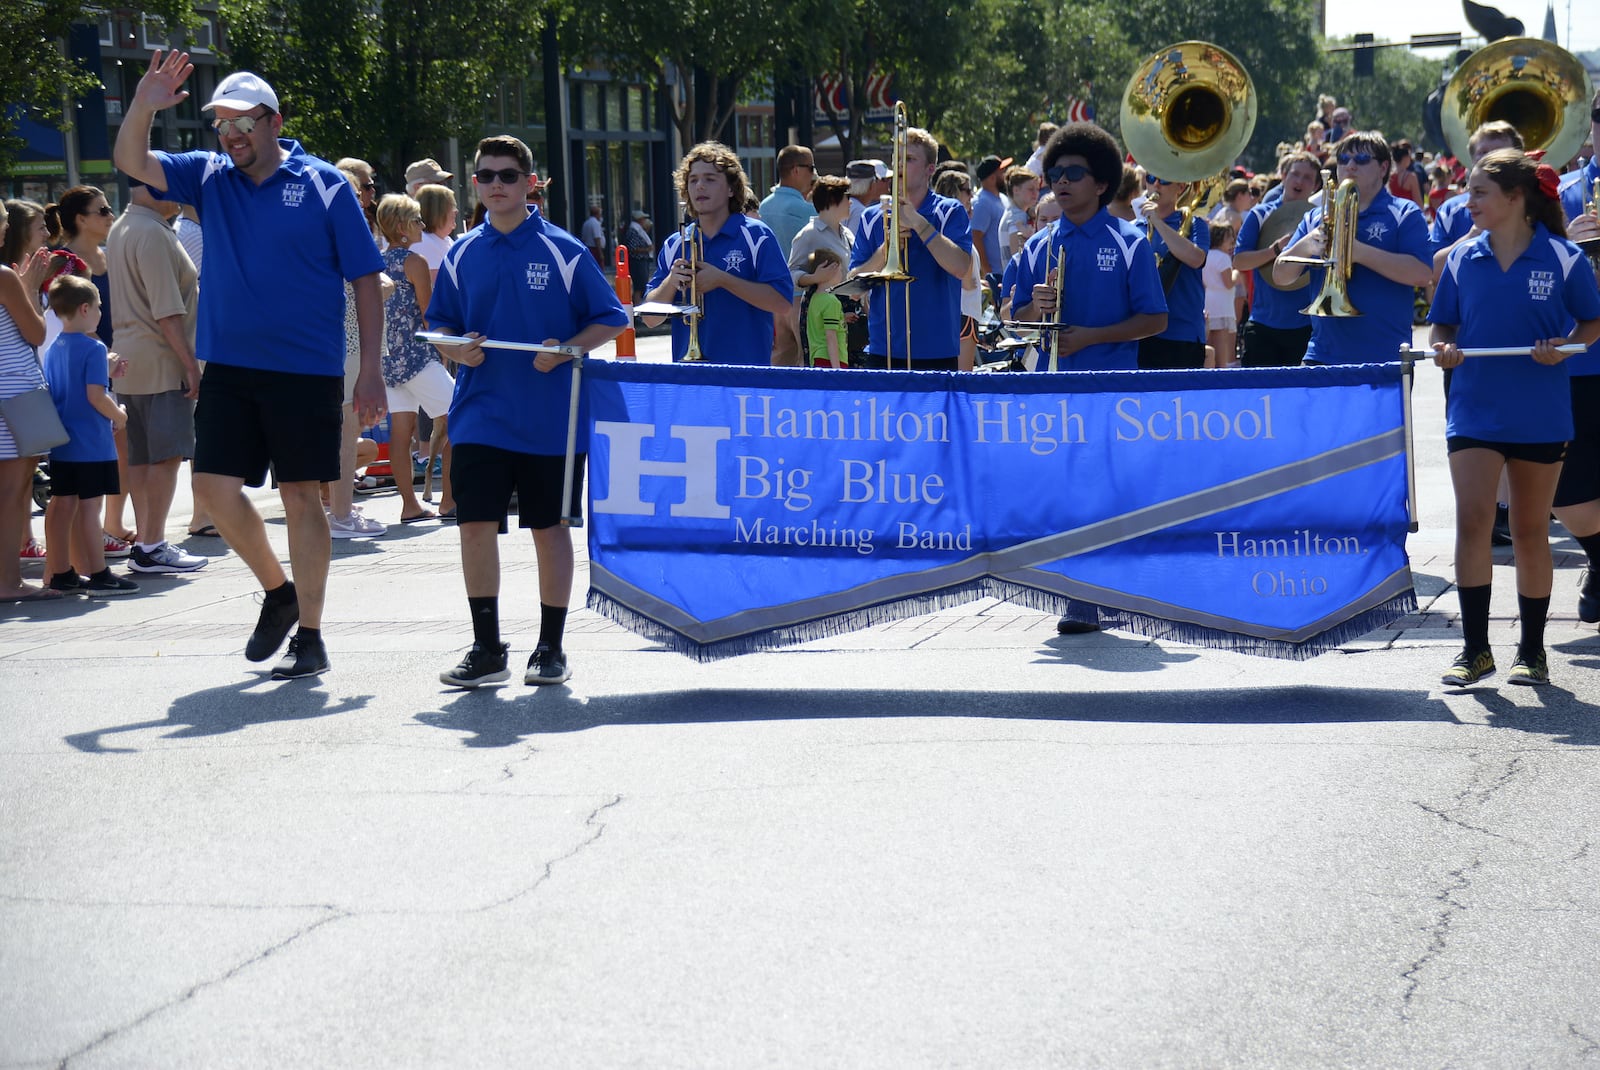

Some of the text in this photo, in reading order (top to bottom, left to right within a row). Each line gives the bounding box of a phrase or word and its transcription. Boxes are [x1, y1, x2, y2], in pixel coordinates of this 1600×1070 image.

[1529, 279, 1554, 288] BIG BLUE
[735, 394, 1276, 456] Hamilton High School
[592, 420, 731, 520] H
[735, 455, 945, 511] Big Blue
[733, 516, 973, 555] Marching Band
[1251, 569, 1328, 597] Ohio
